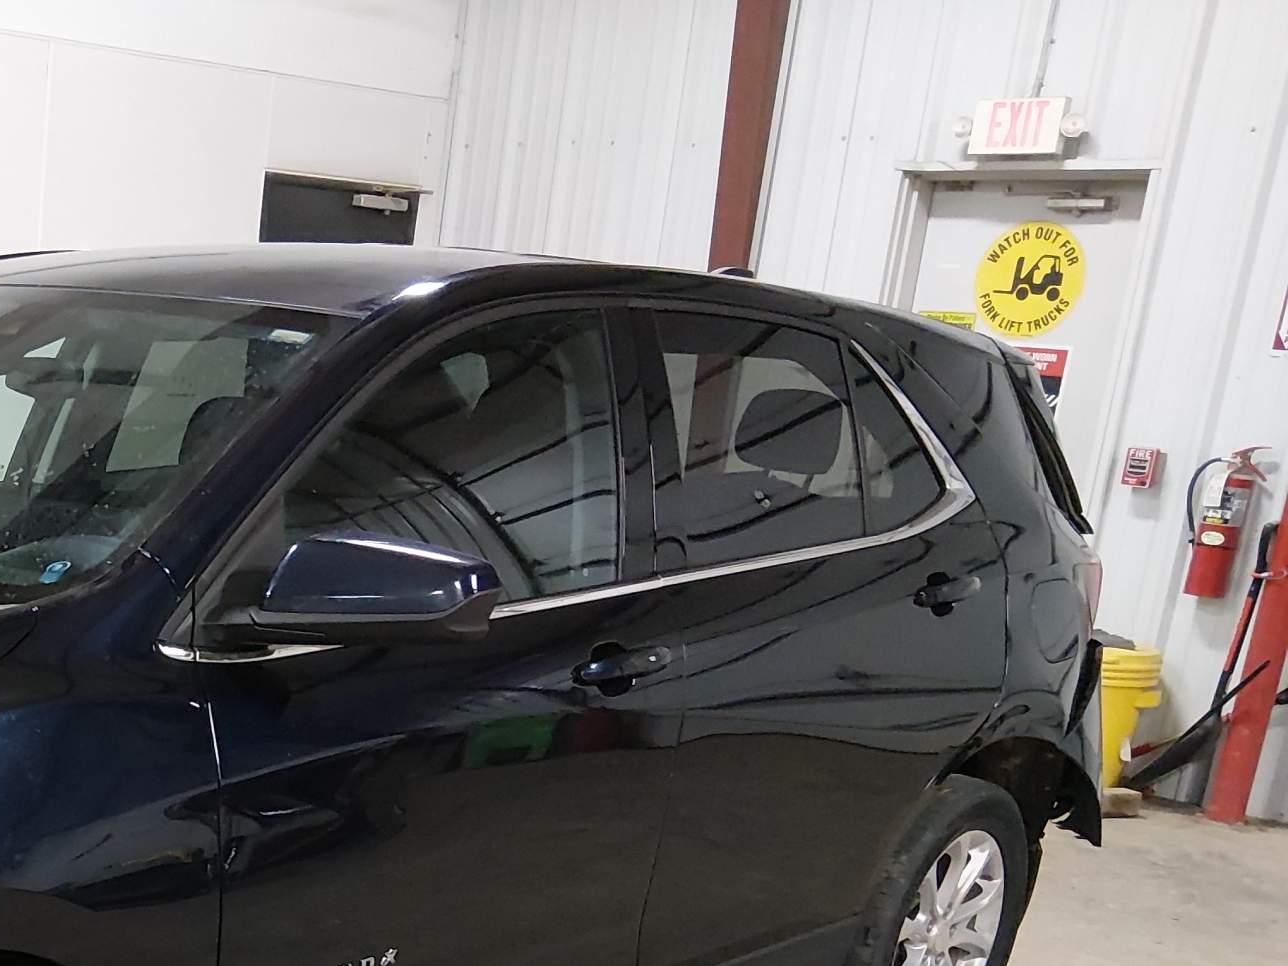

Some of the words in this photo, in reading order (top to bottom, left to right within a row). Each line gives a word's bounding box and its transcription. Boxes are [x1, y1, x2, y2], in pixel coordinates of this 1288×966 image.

[985, 101, 1050, 147] EXIT
[987, 228, 1030, 263] WATCH
[1035, 226, 1062, 244] OUT
[1059, 240, 1079, 267] FOR
[979, 293, 1001, 322] FORK
[998, 317, 1023, 333] LIFT
[1026, 298, 1070, 332] TRUCKS
[1129, 449, 1153, 459] FIRE
